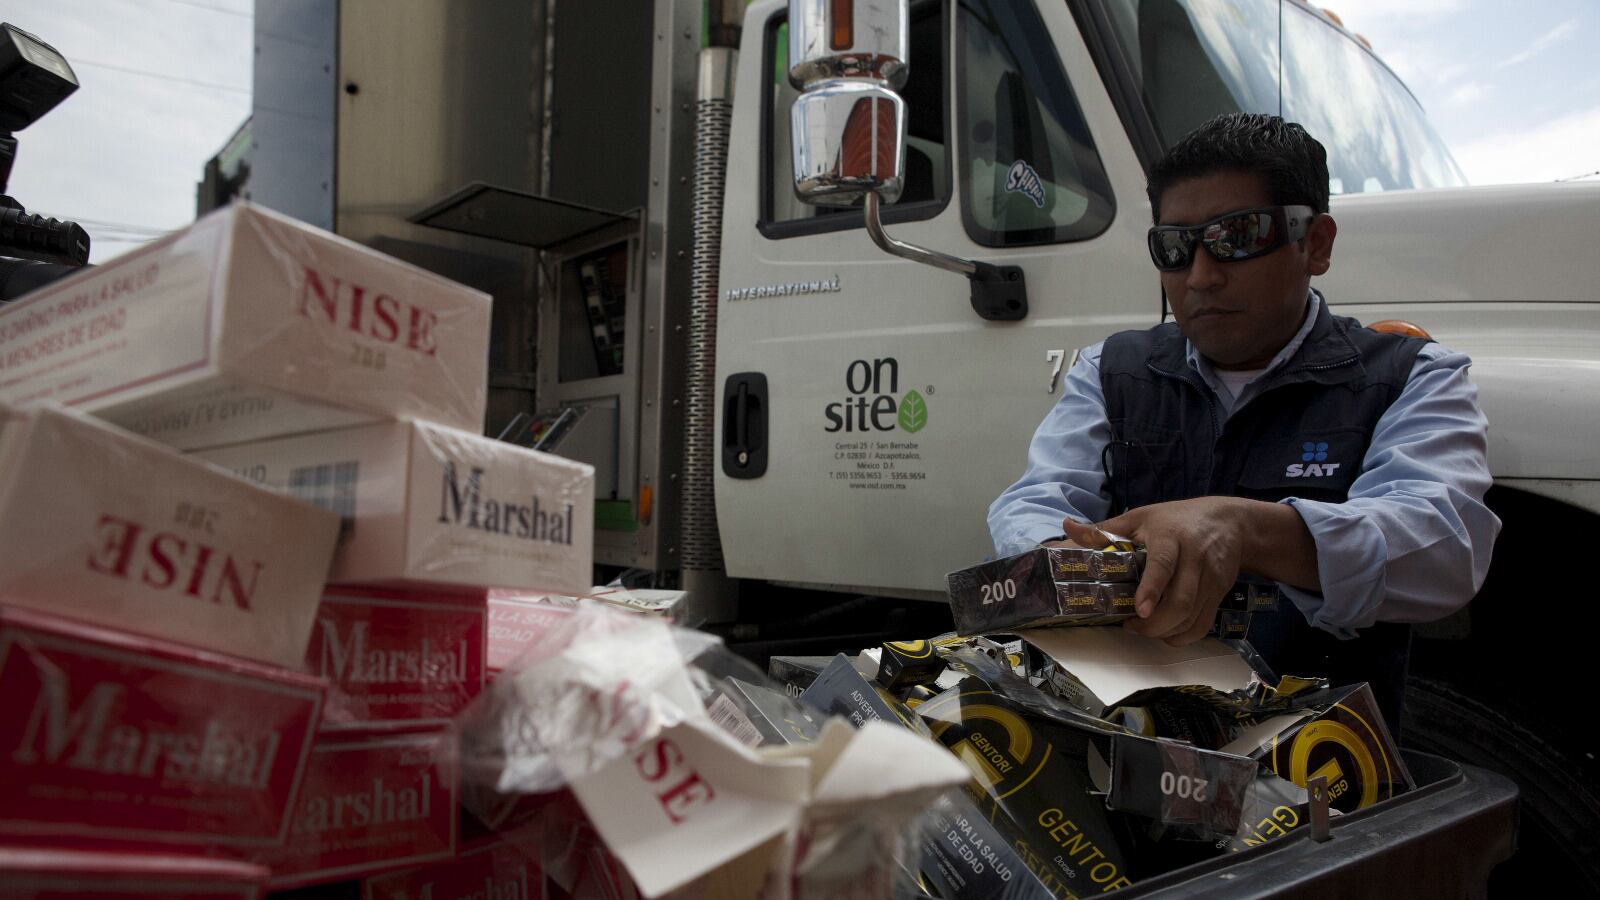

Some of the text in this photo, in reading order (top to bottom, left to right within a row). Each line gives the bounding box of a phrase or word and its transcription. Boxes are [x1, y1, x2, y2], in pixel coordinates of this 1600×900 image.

[110, 262, 159, 299] SALUD
[726, 277, 841, 302] INTERNATIONAL
[68, 323, 87, 348] DE
[89, 307, 127, 341] EDAD
[300, 267, 438, 358] NISE
[846, 357, 898, 395] on
[824, 395, 897, 433] site
[835, 442, 858, 450] Central
[859, 442, 867, 450] 25
[876, 442, 889, 450] San
[847, 452, 866, 460] 02830
[1286, 464, 1340, 478] SAT
[438, 460, 574, 546] Marshal
[86, 514, 264, 614] NISE
[980, 577, 1017, 607] 200
[320, 618, 468, 684] Marshal
[850, 689, 884, 724] ADVERTE
[11, 667, 281, 790] Marshal
[970, 731, 1013, 773] GENTORI
[291, 773, 432, 834] arshal
[1160, 771, 1209, 802] 200
[947, 830, 985, 874] DE EDAD
[954, 814, 1013, 882] ARA LA SALUD
[1038, 808, 1134, 892] GENTOR
[1054, 855, 1076, 879] Dorado
